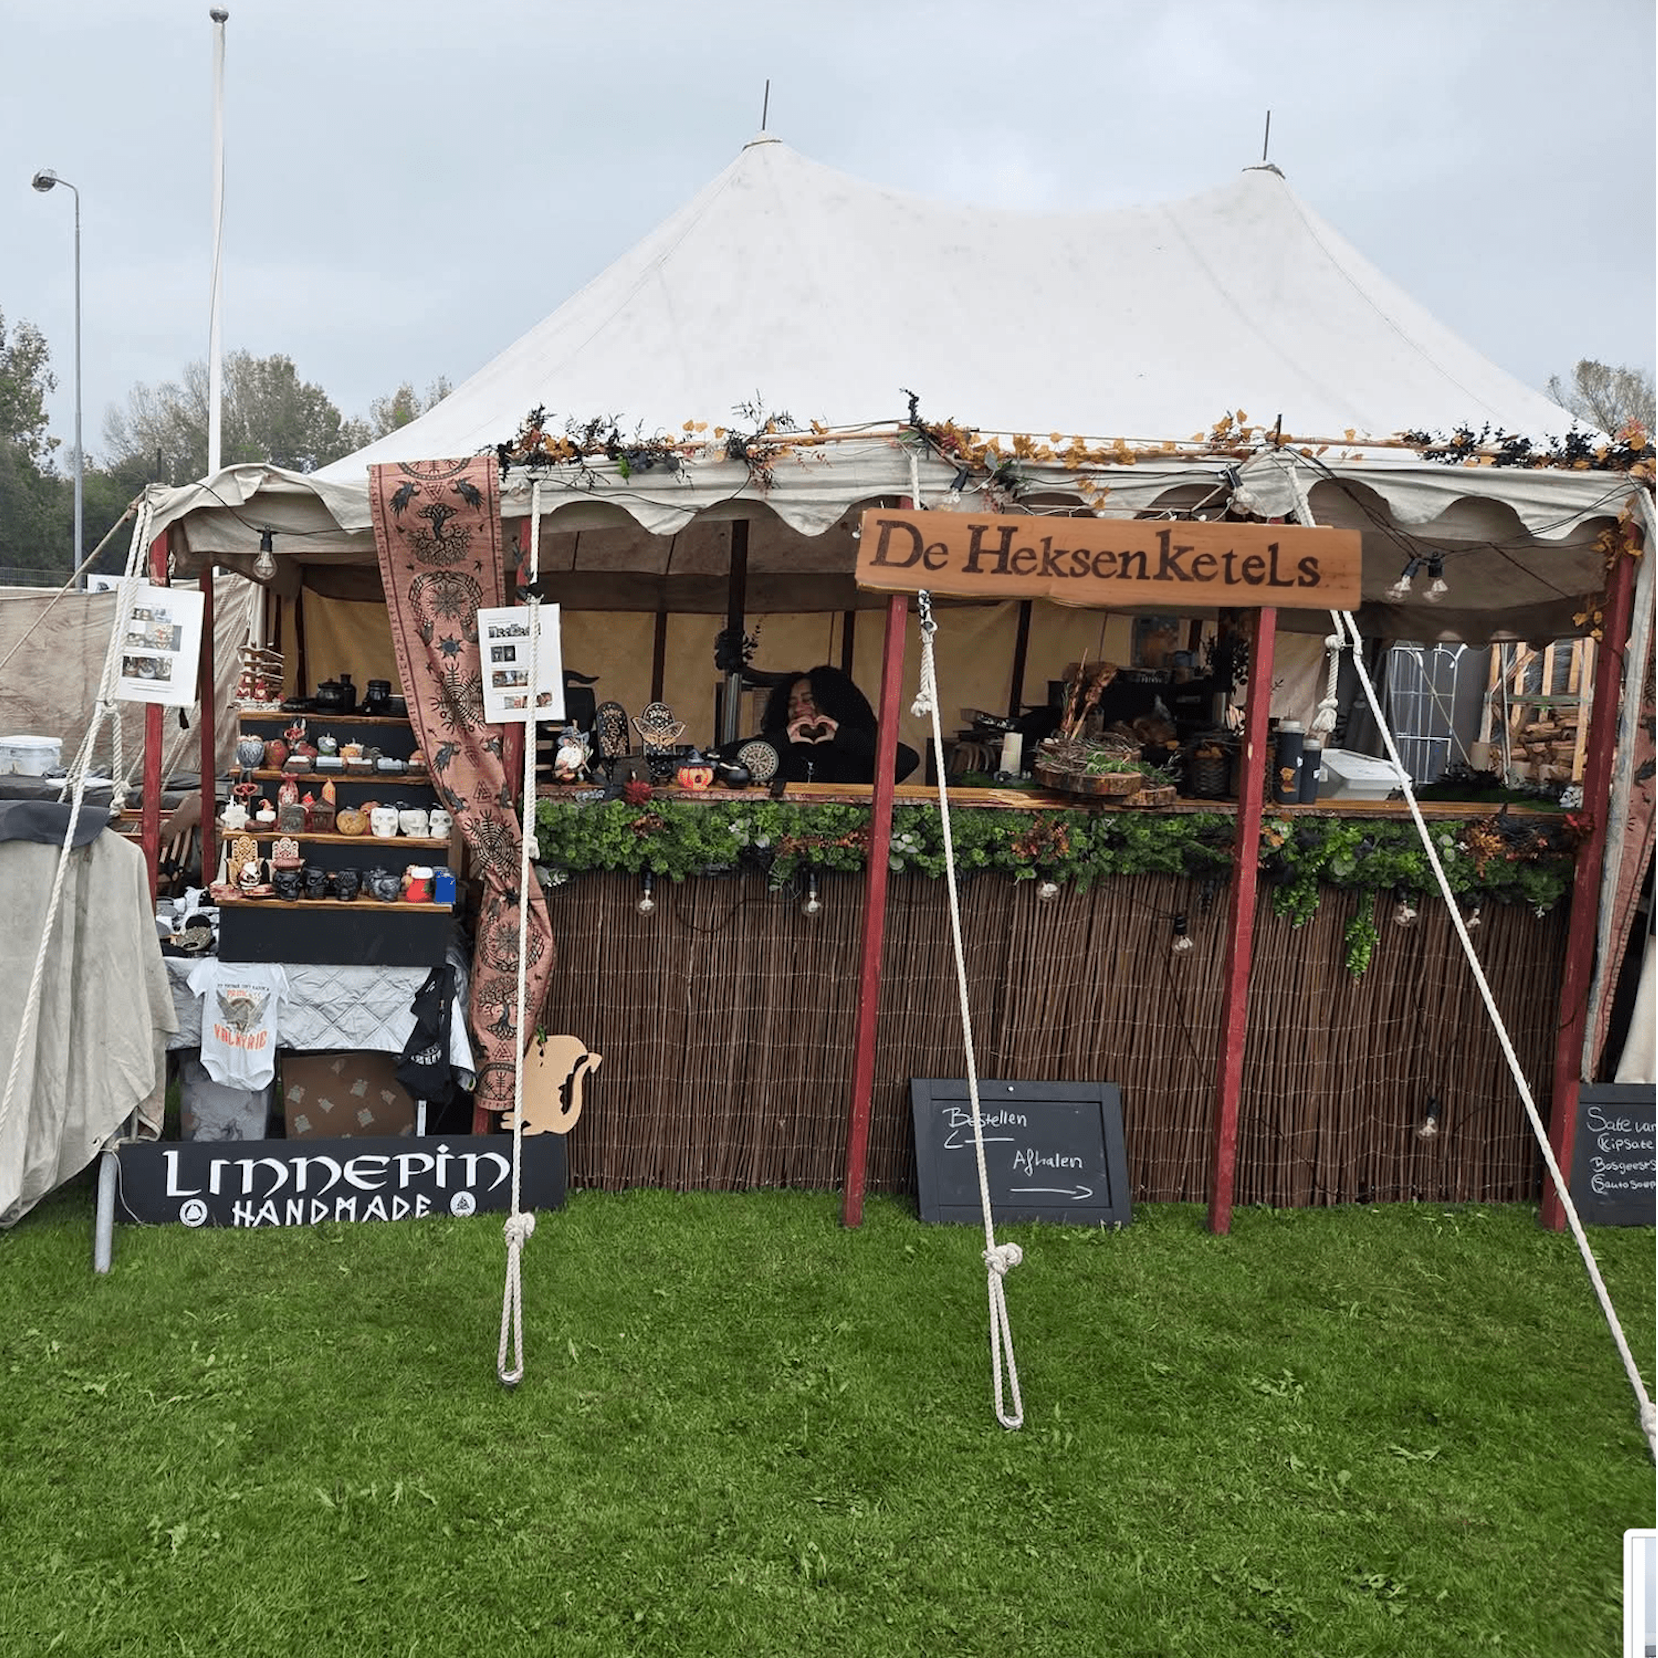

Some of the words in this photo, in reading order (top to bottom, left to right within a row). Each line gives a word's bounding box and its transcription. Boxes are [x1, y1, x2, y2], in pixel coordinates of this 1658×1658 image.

[869, 519, 949, 571] De
[942, 1107, 1027, 1128] Bestellen
[1013, 1148, 1083, 1176] Afhalen
[232, 1193, 432, 1228] HANDMADE
